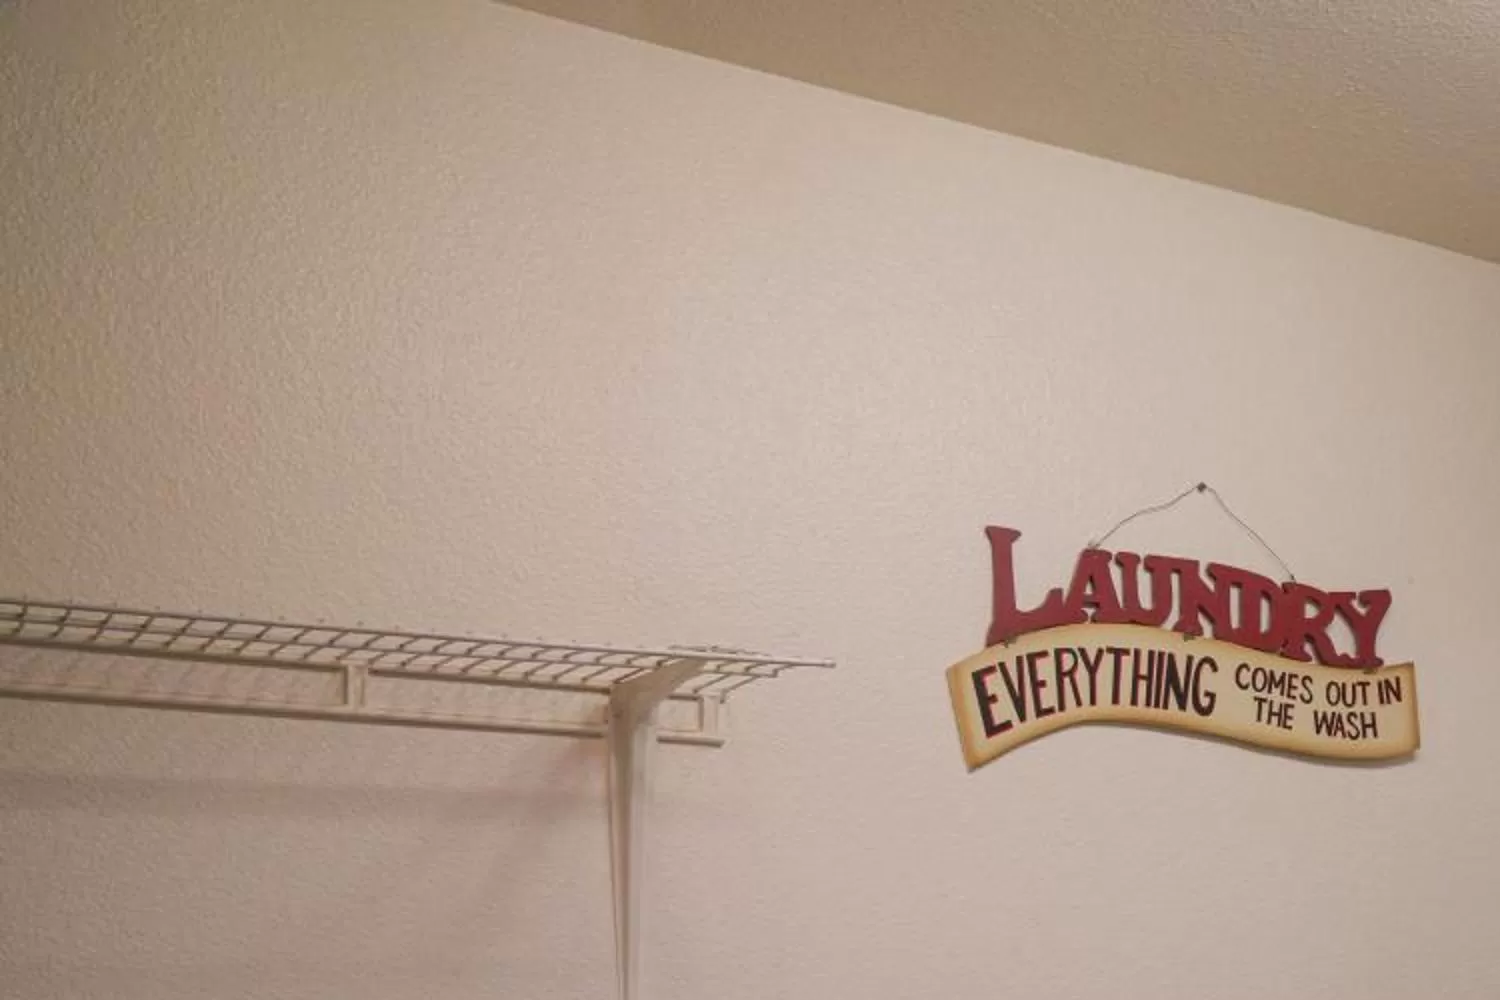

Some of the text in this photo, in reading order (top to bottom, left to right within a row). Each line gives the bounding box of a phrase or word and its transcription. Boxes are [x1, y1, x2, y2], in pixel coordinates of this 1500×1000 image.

[985, 525, 1392, 670] LAUNDRY
[971, 647, 1219, 739] EVERYTHING
[1235, 663, 1402, 707] COMES OUT IN
[1253, 697, 1379, 740] THE WASH
